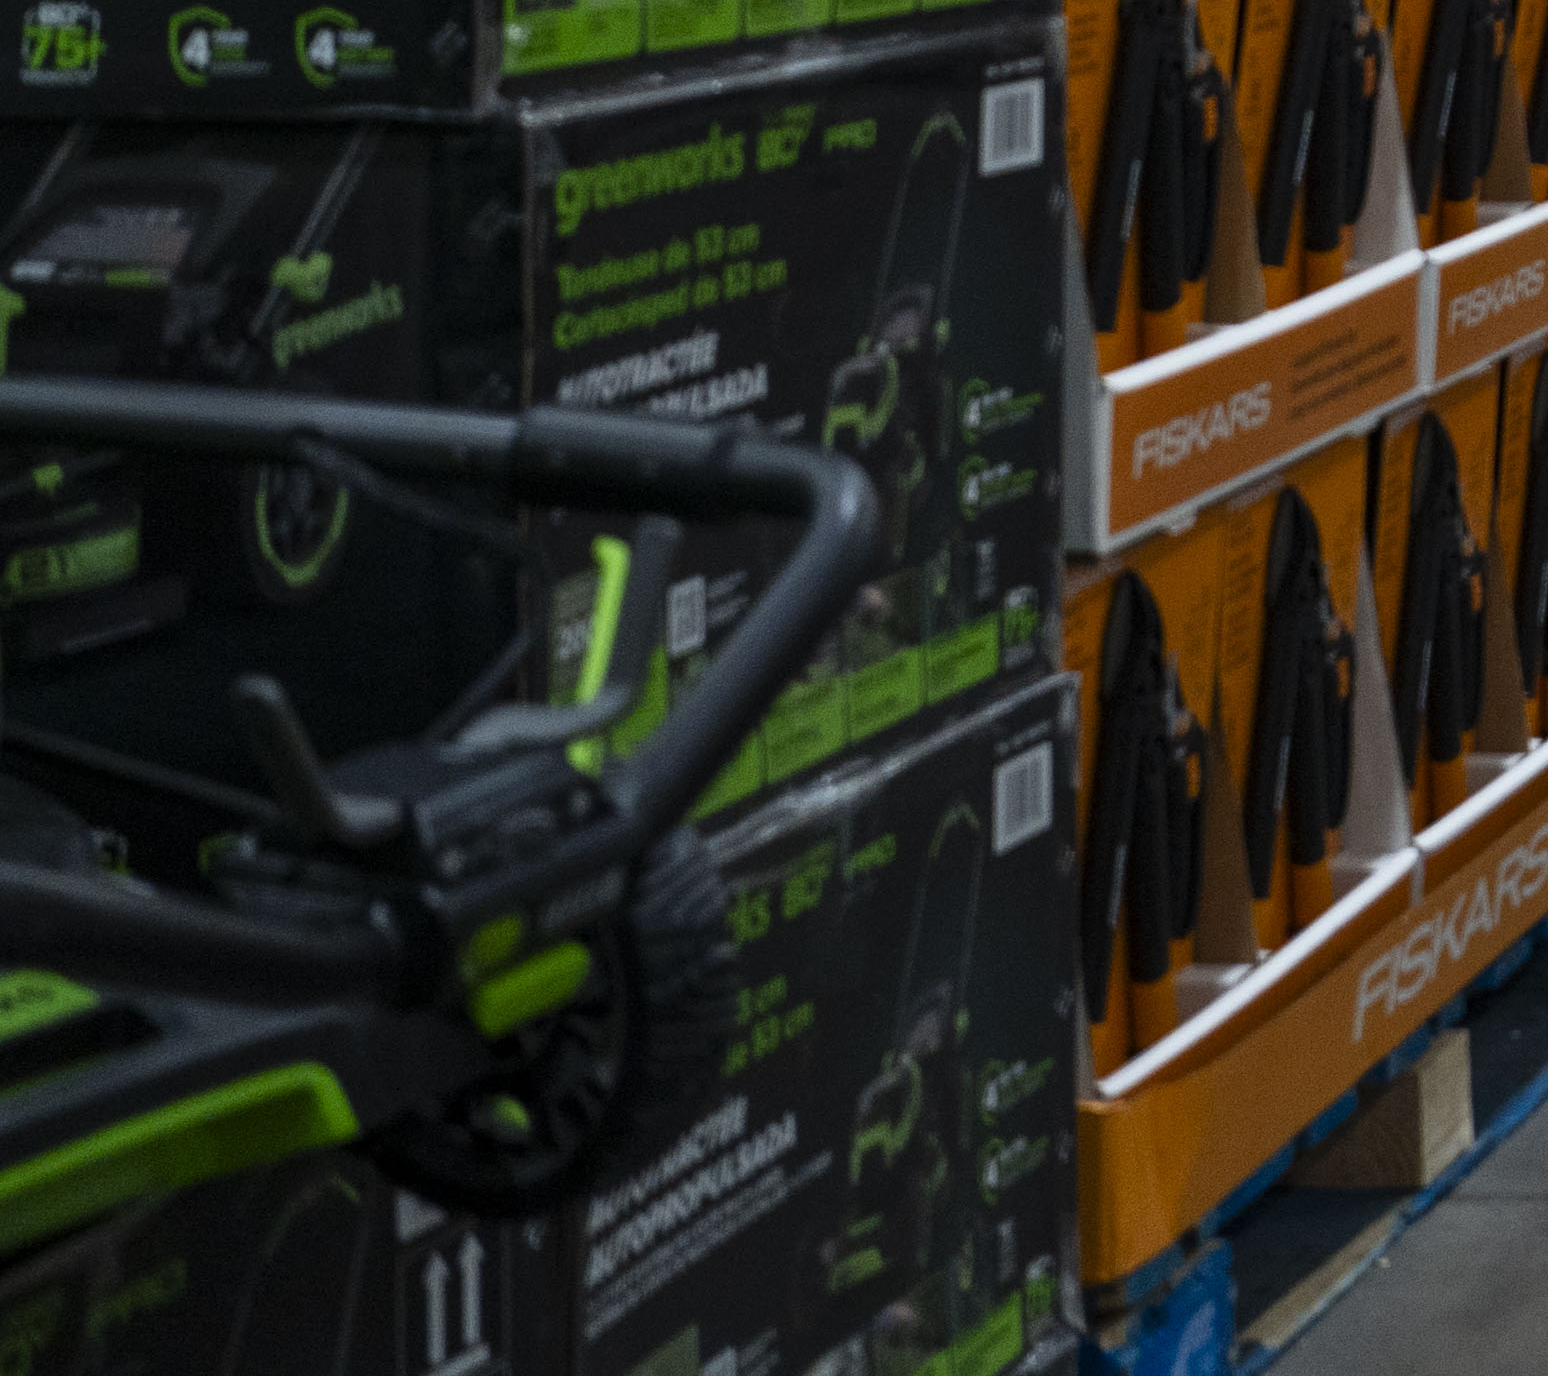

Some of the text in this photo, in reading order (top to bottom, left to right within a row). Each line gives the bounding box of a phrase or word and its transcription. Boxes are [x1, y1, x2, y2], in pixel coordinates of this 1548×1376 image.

[554, 127, 743, 237] greenworks
[1448, 259, 1545, 337] FISKARS
[1133, 382, 1273, 482] FISKARS
